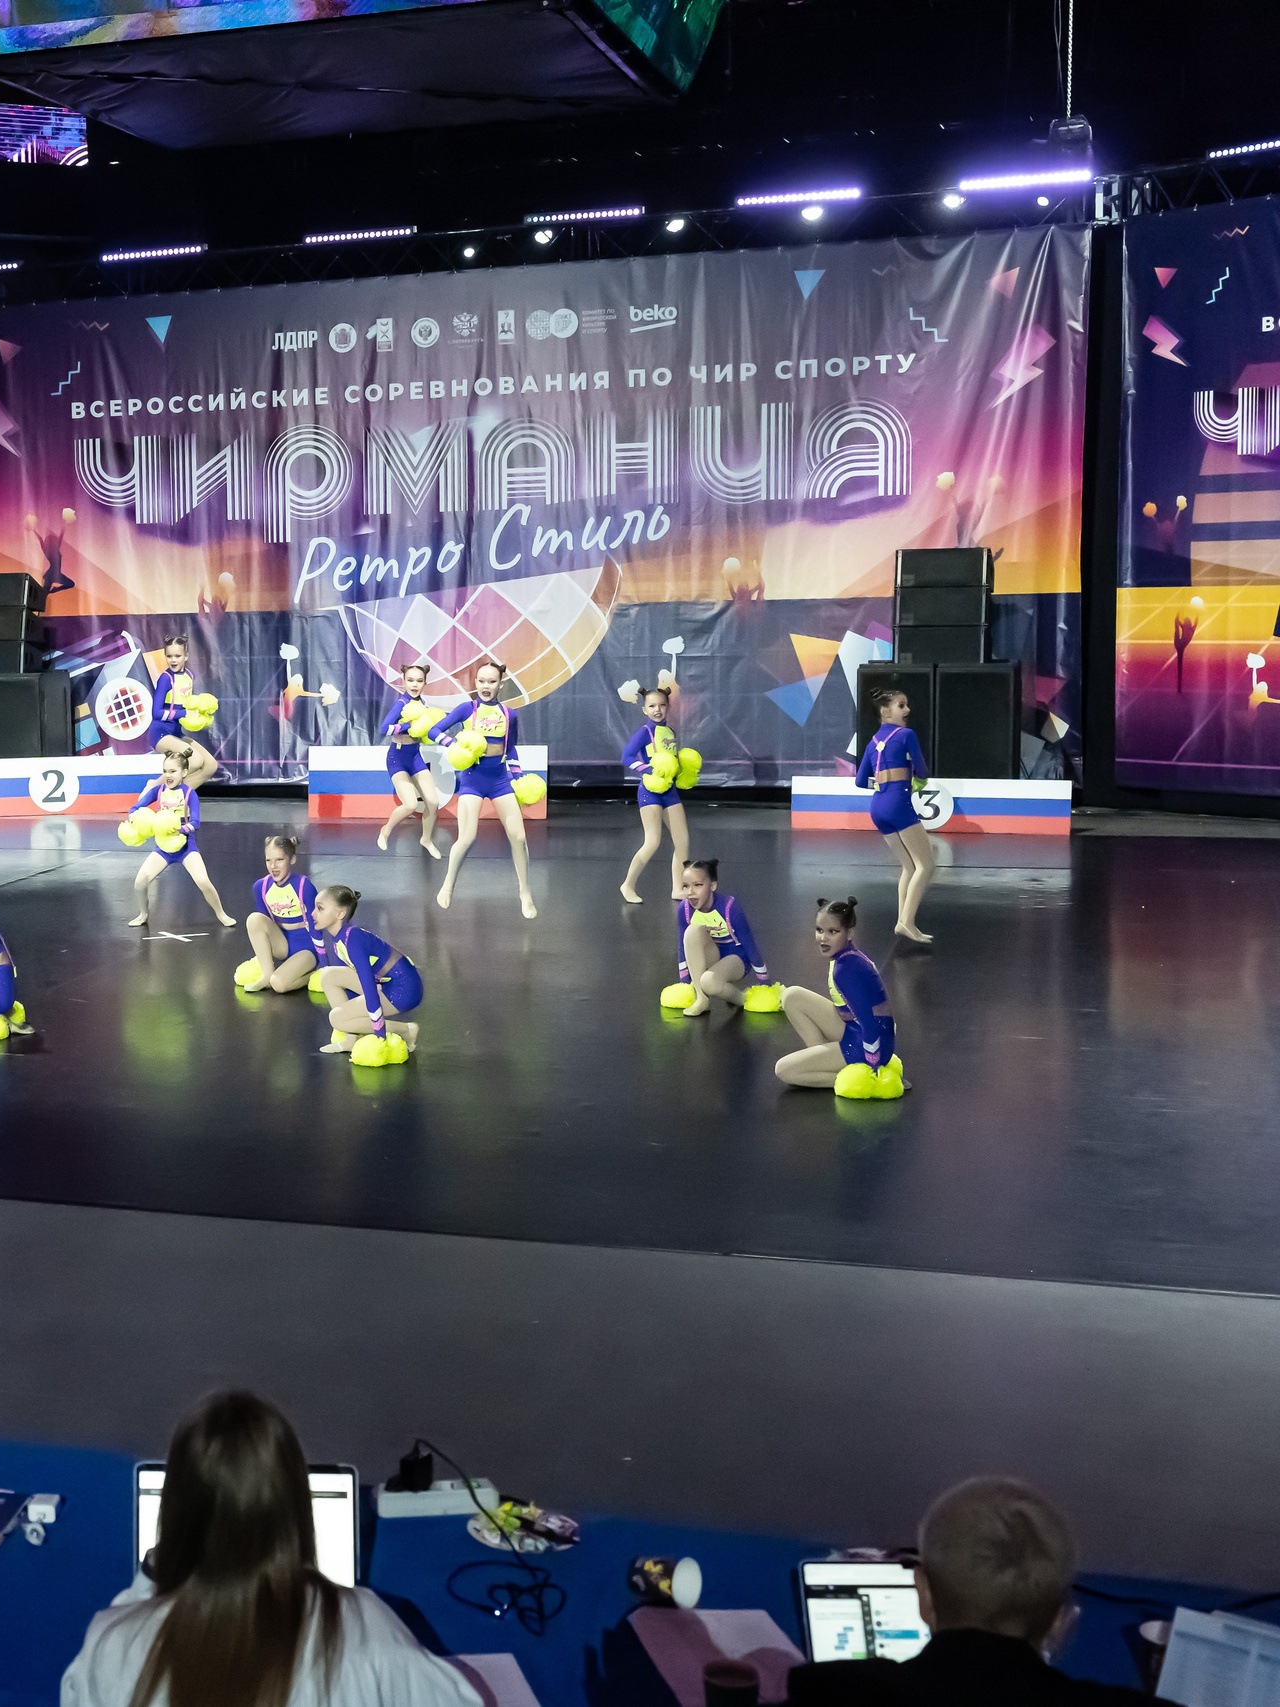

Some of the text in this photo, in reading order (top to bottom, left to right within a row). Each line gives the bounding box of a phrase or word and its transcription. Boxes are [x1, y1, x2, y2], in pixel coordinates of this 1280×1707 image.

[629, 304, 678, 322] beko
[1261, 316, 1280, 333] В
[271, 330, 319, 352] ЛДПР
[70, 353, 916, 419] ВСЕРОССИЙСКИЕ СОРЕВНОВАНИЯ ПО ЧИР СПОРТУ
[293, 503, 672, 605] Ретро Стиль
[41, 769, 67, 803] 2
[918, 790, 941, 821] 3
